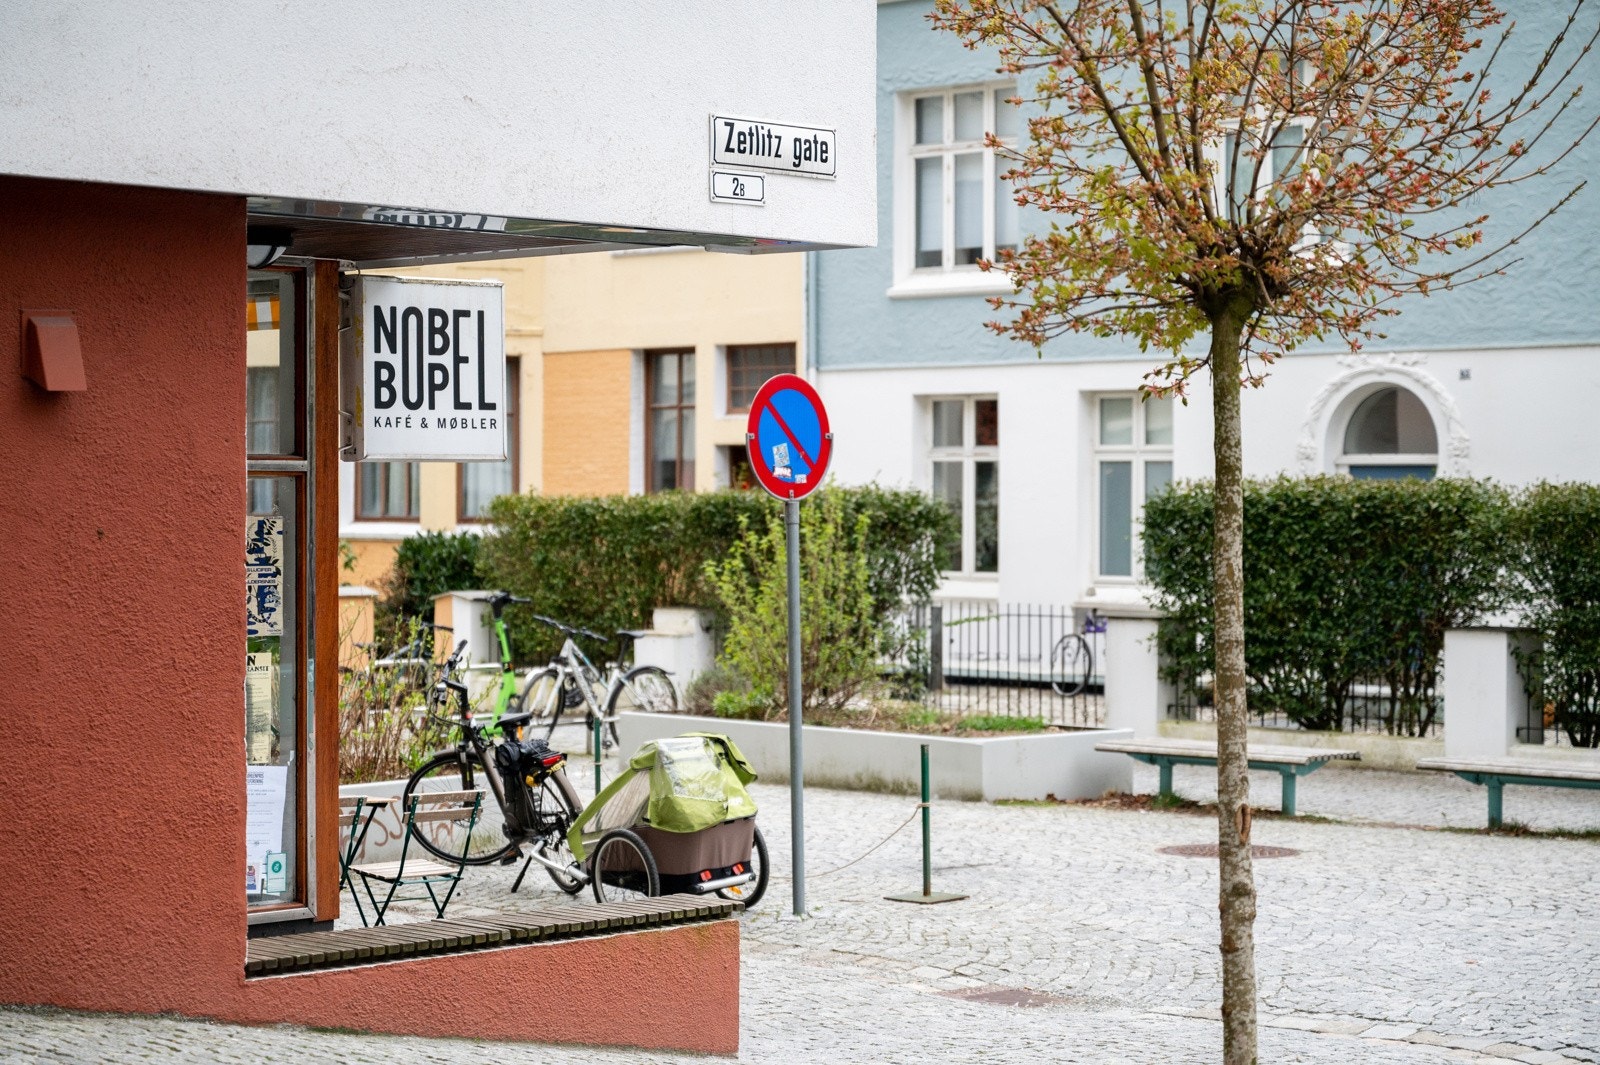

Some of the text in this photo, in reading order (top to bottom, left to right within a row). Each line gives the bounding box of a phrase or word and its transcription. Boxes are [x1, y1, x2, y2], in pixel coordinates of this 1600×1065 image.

[724, 121, 829, 168] Zetlitz gate
[732, 177, 746, 197] 2B
[374, 415, 497, 430] KAFÉ & MØBLER
